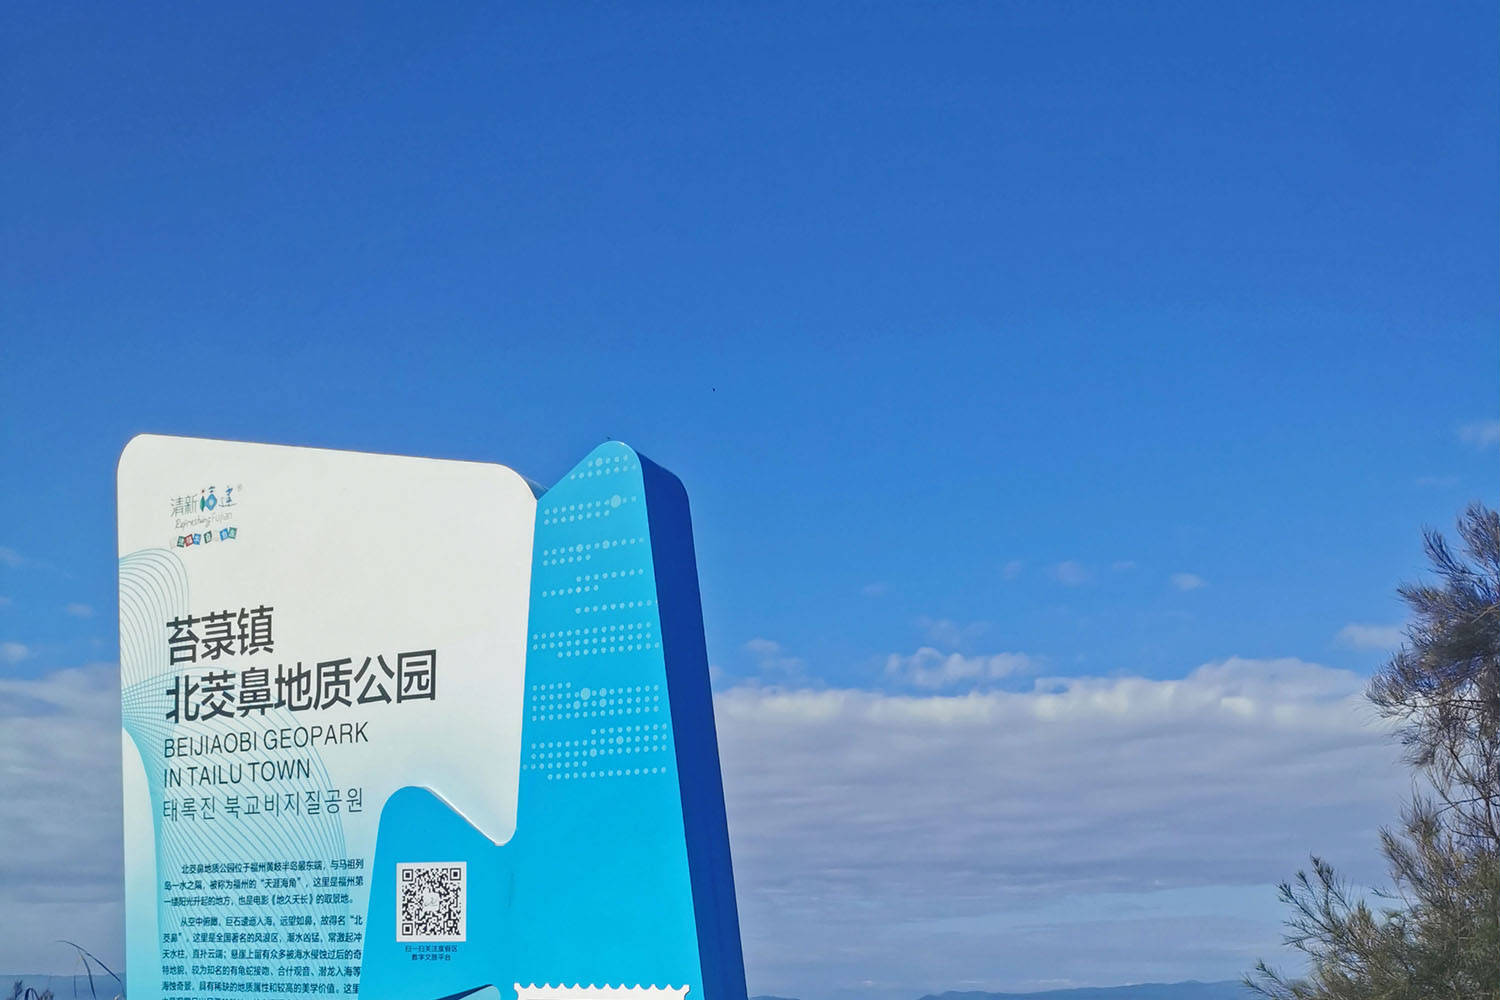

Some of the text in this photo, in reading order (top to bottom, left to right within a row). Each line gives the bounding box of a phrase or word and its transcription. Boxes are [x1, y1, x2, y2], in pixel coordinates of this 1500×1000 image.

[166, 605, 274, 666] 苔菉镇
[166, 649, 437, 724] 北茭鼻地质公园
[164, 721, 369, 758] BEIJIAOBI GEOPARK
[164, 758, 310, 788] IN TAILU TOWN
[163, 787, 363, 821] 태록진 북교비지질공원
